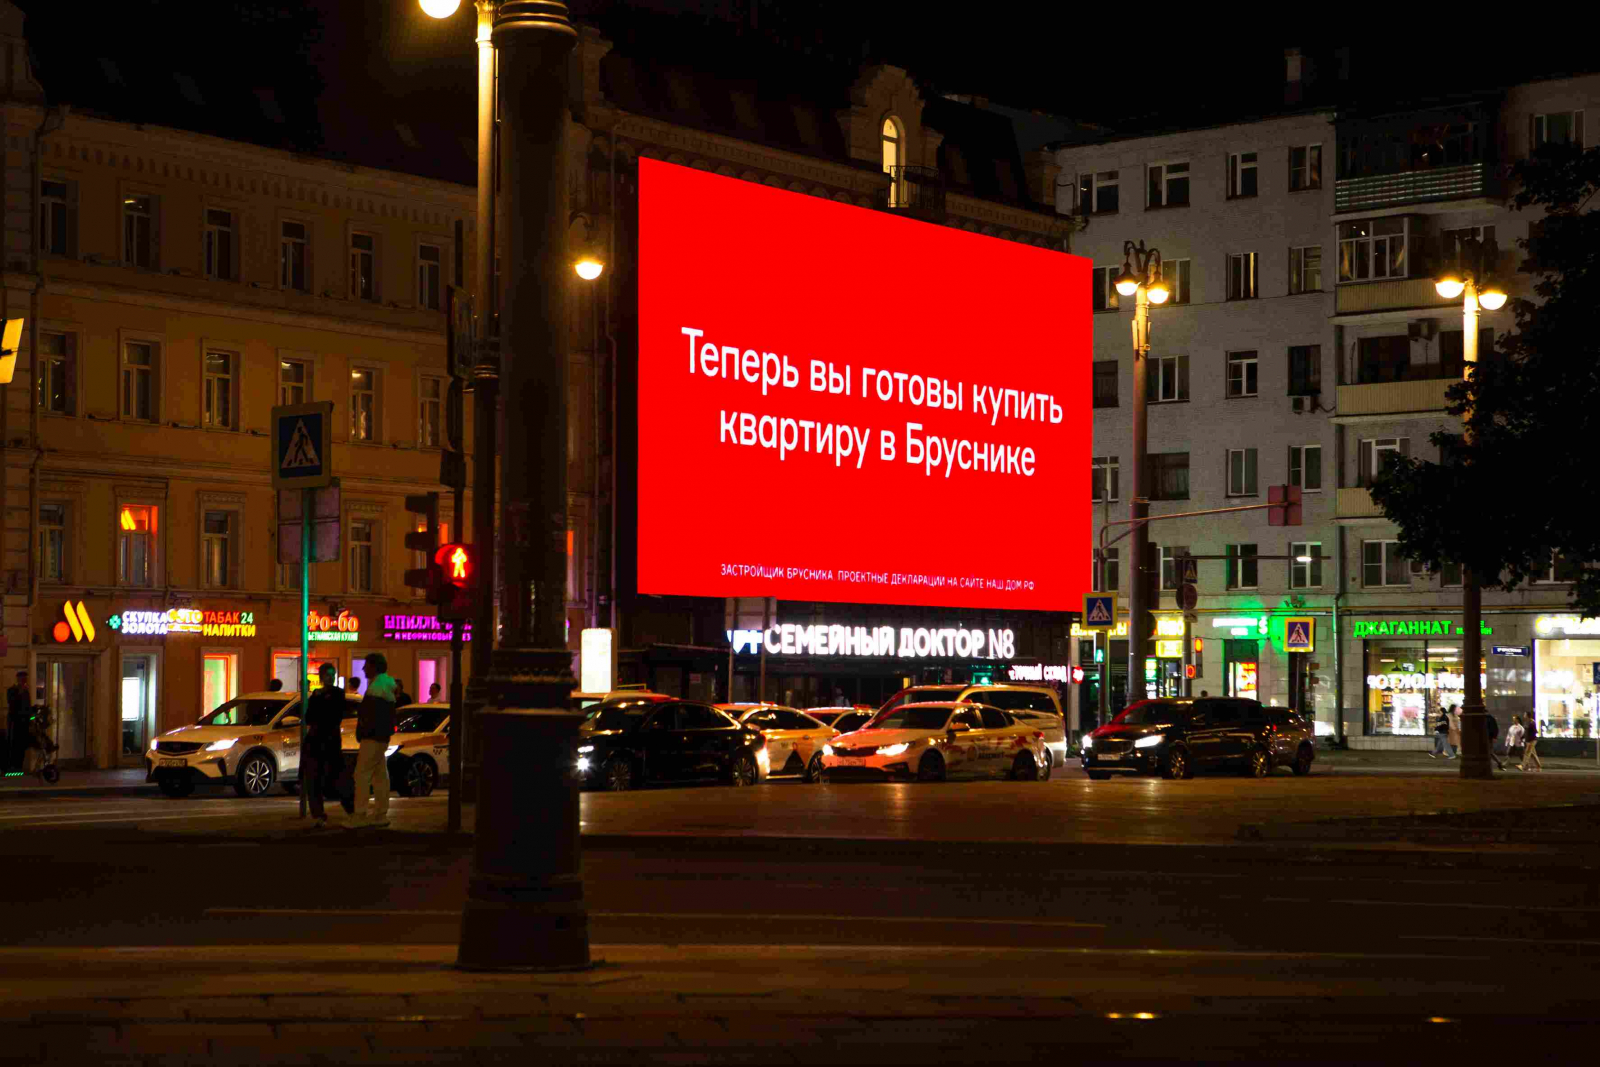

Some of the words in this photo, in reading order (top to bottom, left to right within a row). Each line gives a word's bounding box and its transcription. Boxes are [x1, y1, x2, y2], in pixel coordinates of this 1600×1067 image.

[681, 326, 800, 396] Теперь
[810, 359, 851, 396] вы
[862, 367, 963, 411] готовы
[972, 384, 1064, 426] купить
[720, 409, 871, 469] квартиру
[880, 429, 896, 461] в
[906, 421, 1036, 477] Бруснике
[720, 563, 785, 580] ЗАСТРОЙЩИК
[837, 570, 889, 584] ПРОЕКТНЫЕ
[890, 573, 946, 588] ДЕКЛАРАЦИИ
[946, 576, 958, 587] НА
[959, 575, 984, 589] САЙТЕ
[122, 611, 167, 624] СКУПКА
[203, 611, 240, 624] ТАБАК
[241, 612, 254, 625] 24
[121, 622, 168, 635] ЗОЛОТА
[203, 623, 256, 637] НАПИТКИ
[1353, 620, 1451, 638] ДЖАГАННАТ
[764, 624, 896, 657] СЕМЕЙНЫЙ
[898, 628, 985, 658] ДОКТОР
